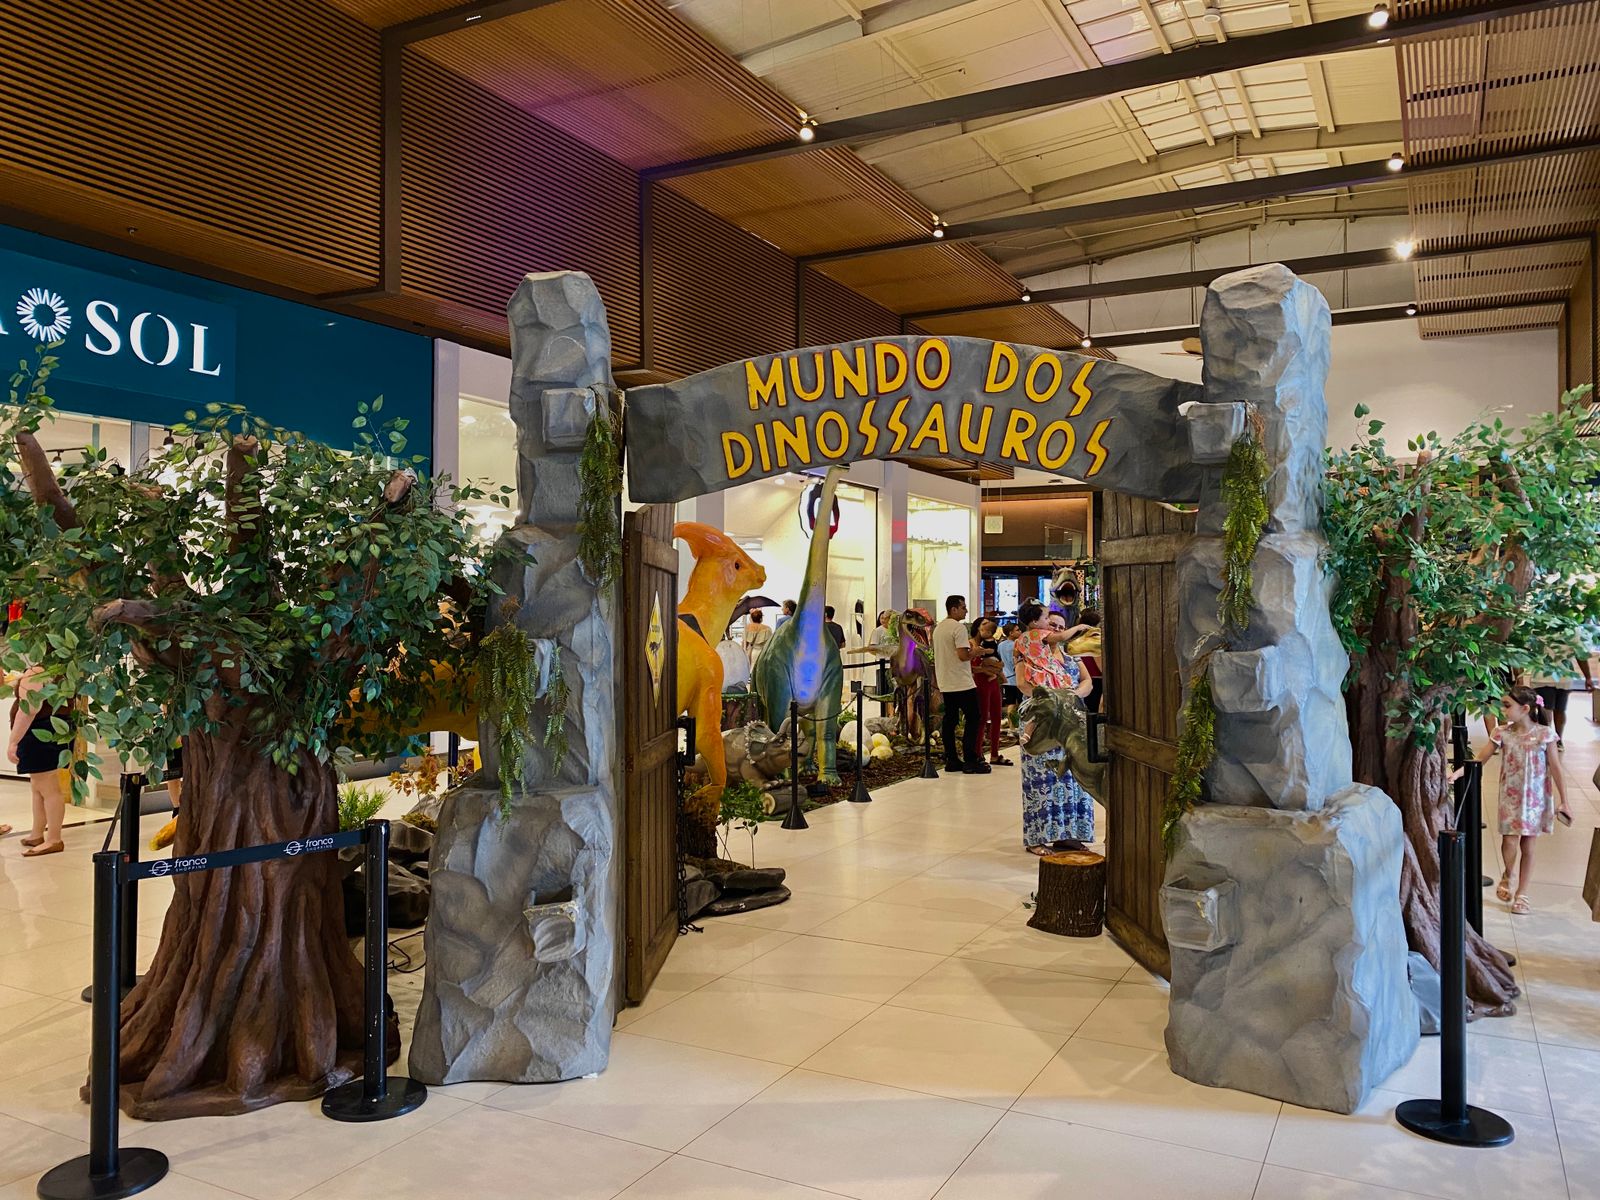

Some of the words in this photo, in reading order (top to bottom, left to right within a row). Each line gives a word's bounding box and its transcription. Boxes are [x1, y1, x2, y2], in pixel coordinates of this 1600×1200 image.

[85, 300, 221, 376] SOL
[744, 338, 951, 410] MUNDO
[984, 341, 1097, 418] DOS
[720, 395, 1114, 479] DINOSSAUROS
[174, 857, 207, 868] franca
[305, 837, 334, 848] franca
